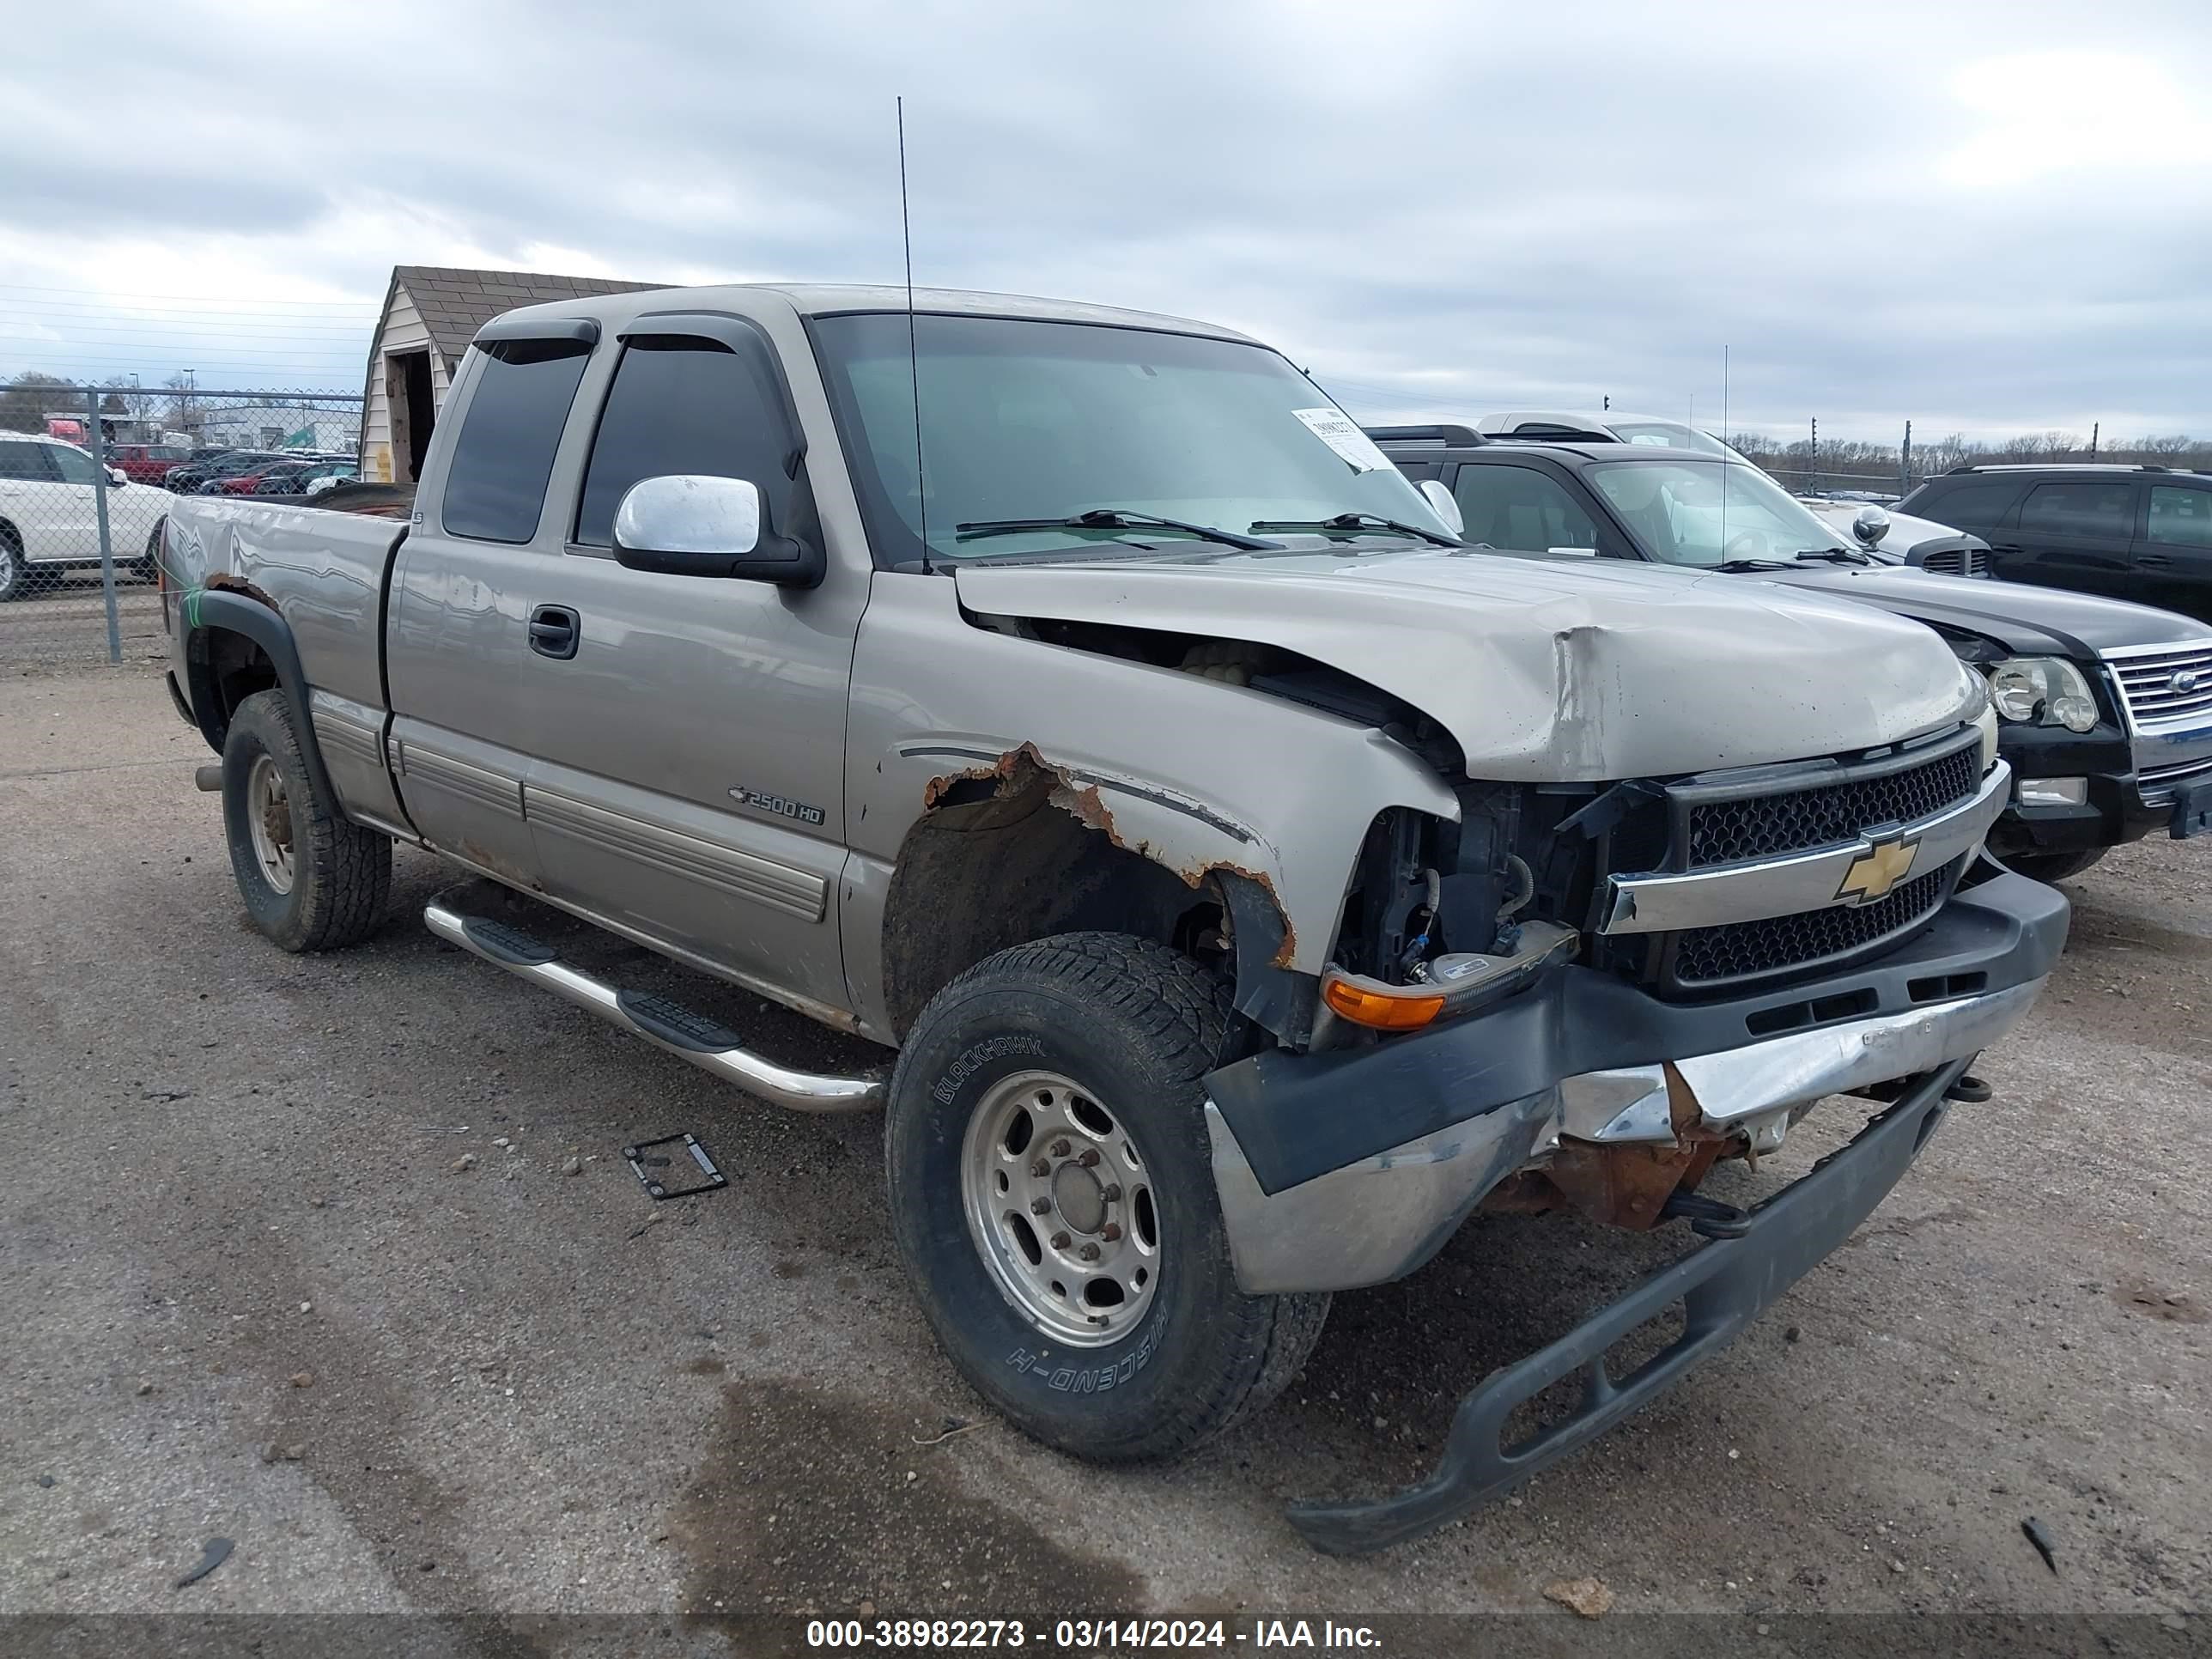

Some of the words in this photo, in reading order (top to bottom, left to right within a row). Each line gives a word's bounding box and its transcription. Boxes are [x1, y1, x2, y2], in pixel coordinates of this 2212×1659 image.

[749, 792, 797, 817] 2500
[799, 806, 821, 823] HD
[933, 1036, 1047, 1106] BLACKHAWK
